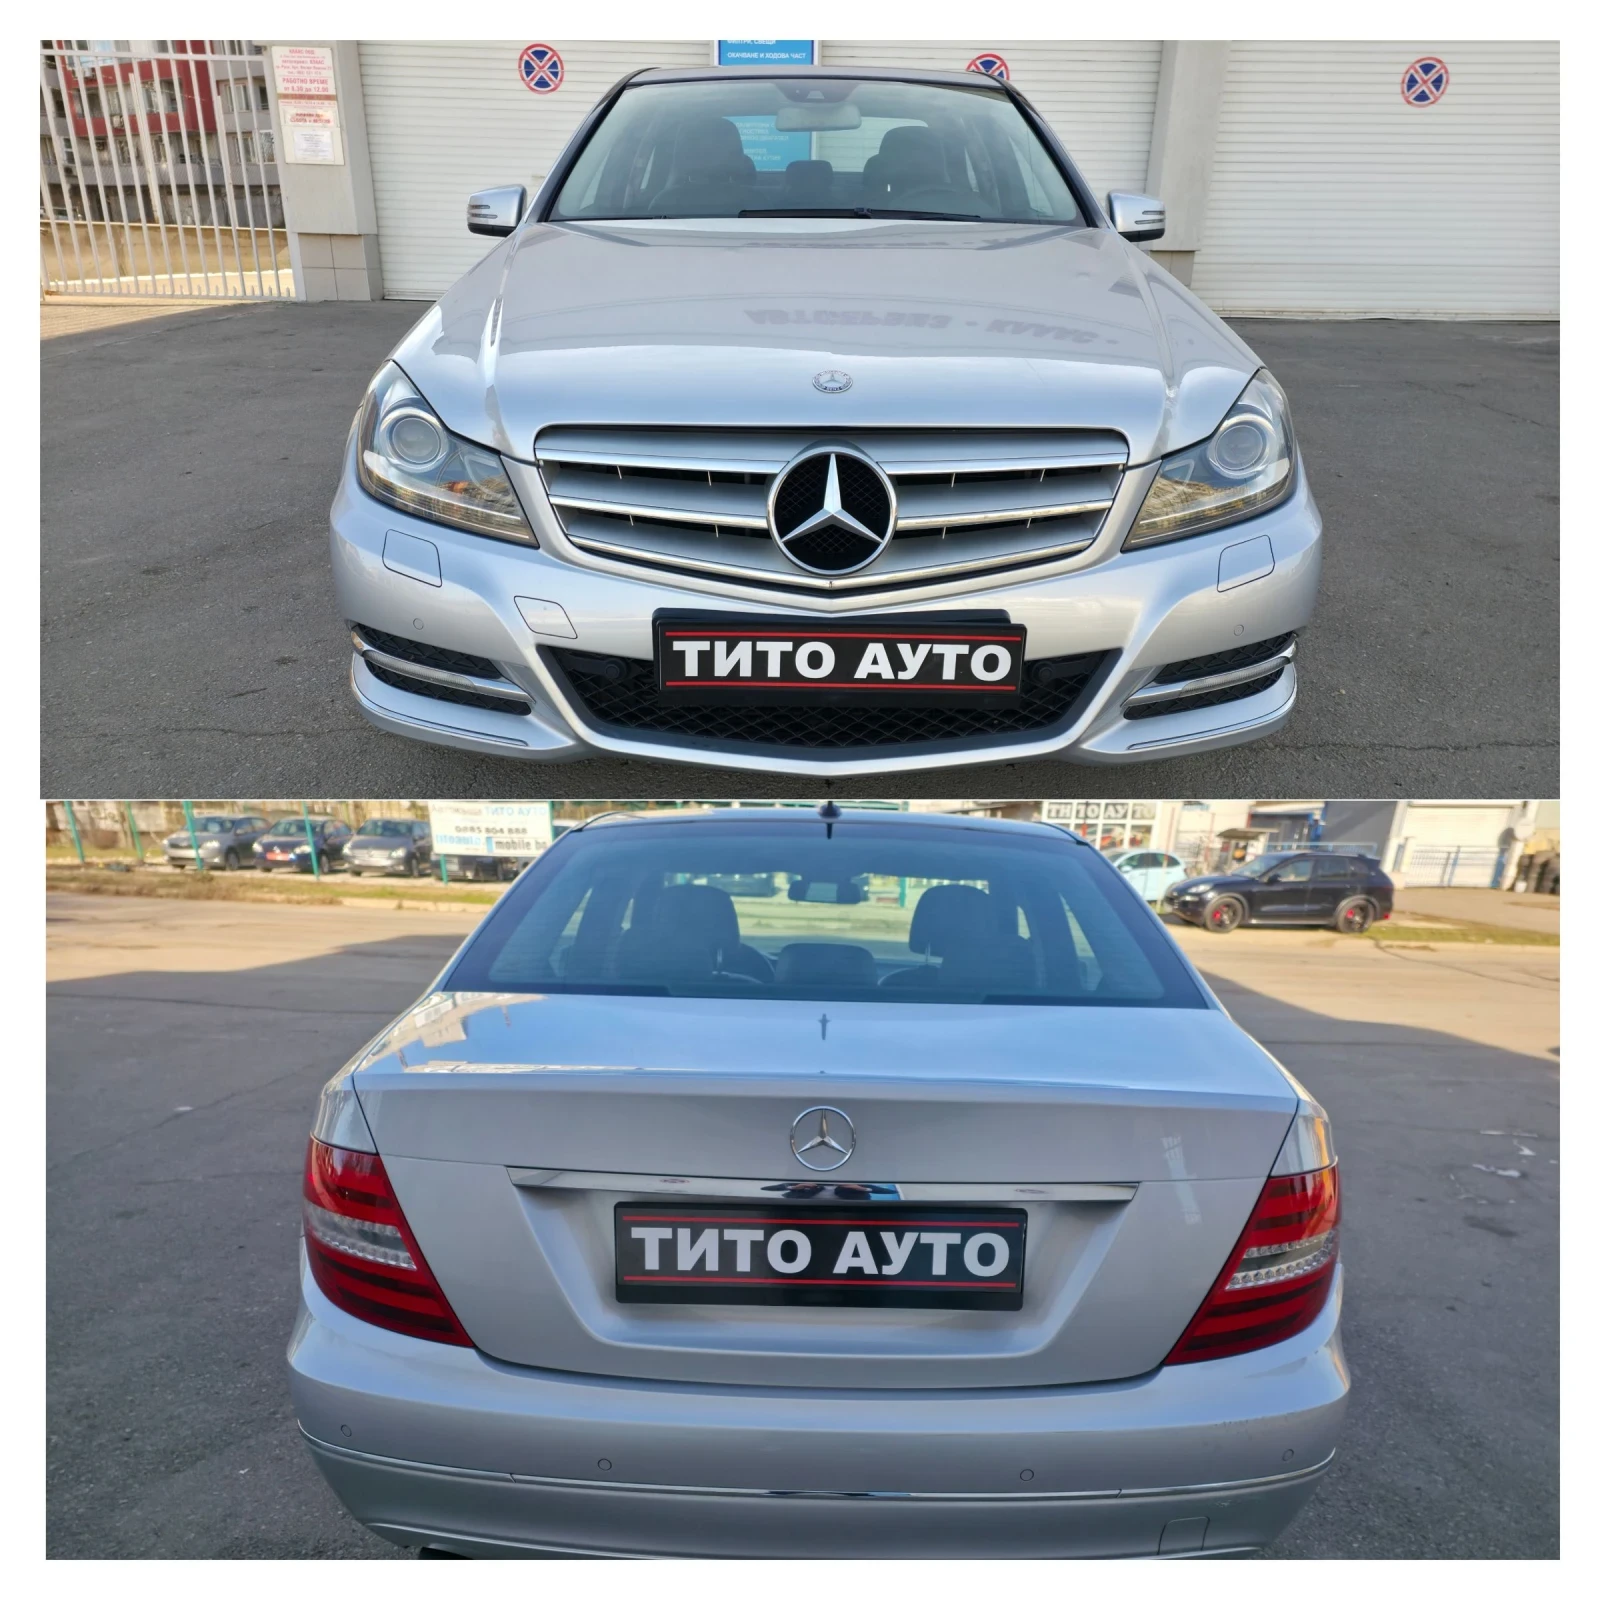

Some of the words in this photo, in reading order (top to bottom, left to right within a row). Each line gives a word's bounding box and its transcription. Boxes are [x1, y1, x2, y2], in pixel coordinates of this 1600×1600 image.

[673, 641, 836, 679] ТИТО
[853, 643, 1012, 681] АУТО
[484, 806, 514, 815] ТИТО
[518, 807, 547, 816] АУТО
[631, 1227, 811, 1274] ТИТО
[833, 1231, 1010, 1277] АУТО
